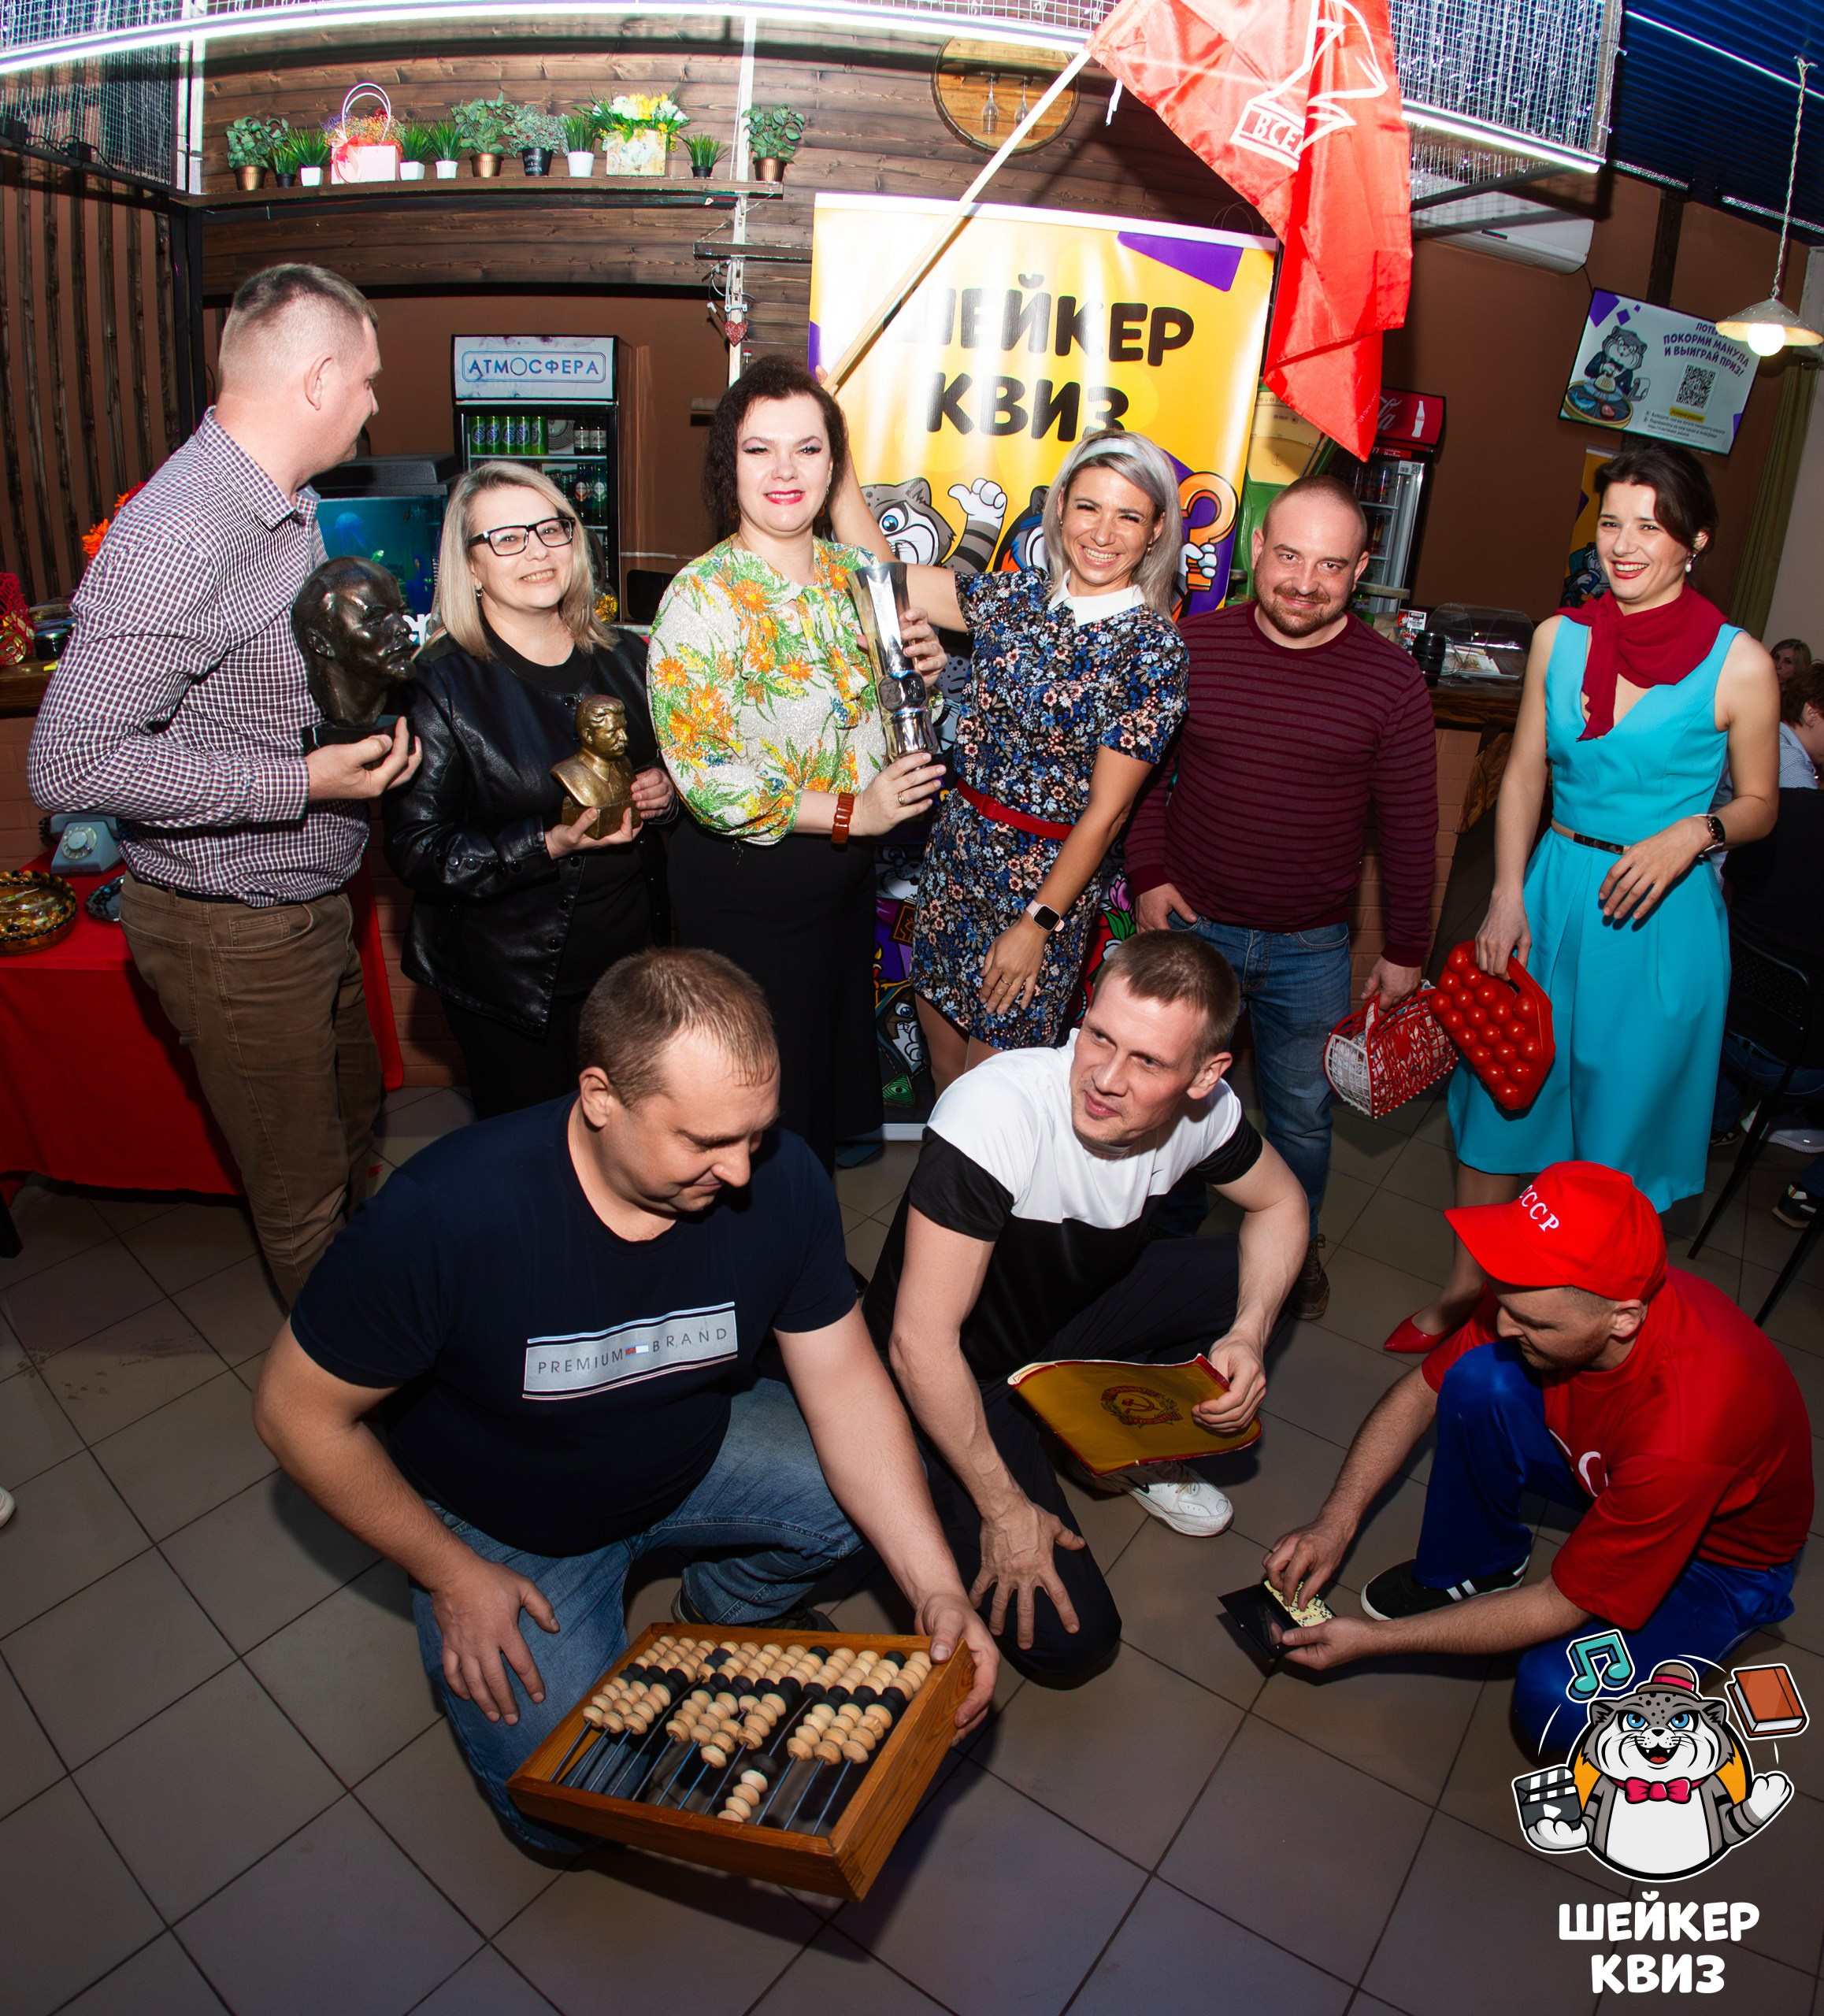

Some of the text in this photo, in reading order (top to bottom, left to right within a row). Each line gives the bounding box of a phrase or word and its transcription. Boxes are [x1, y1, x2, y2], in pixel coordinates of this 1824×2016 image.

[1252, 112, 1303, 156] ВСЕ
[1696, 323, 1728, 339] ЛОТЕ
[1663, 333, 1749, 367] ПОКОРМИ МАНУЛА
[1664, 346, 1744, 377] И ВЫИГРАЙ ПРИЗ!
[468, 357, 599, 380] АТМОСФЕРА
[925, 372, 1129, 443] КВИЗ
[538, 1328, 727, 1374] PREMIUM BRAND
